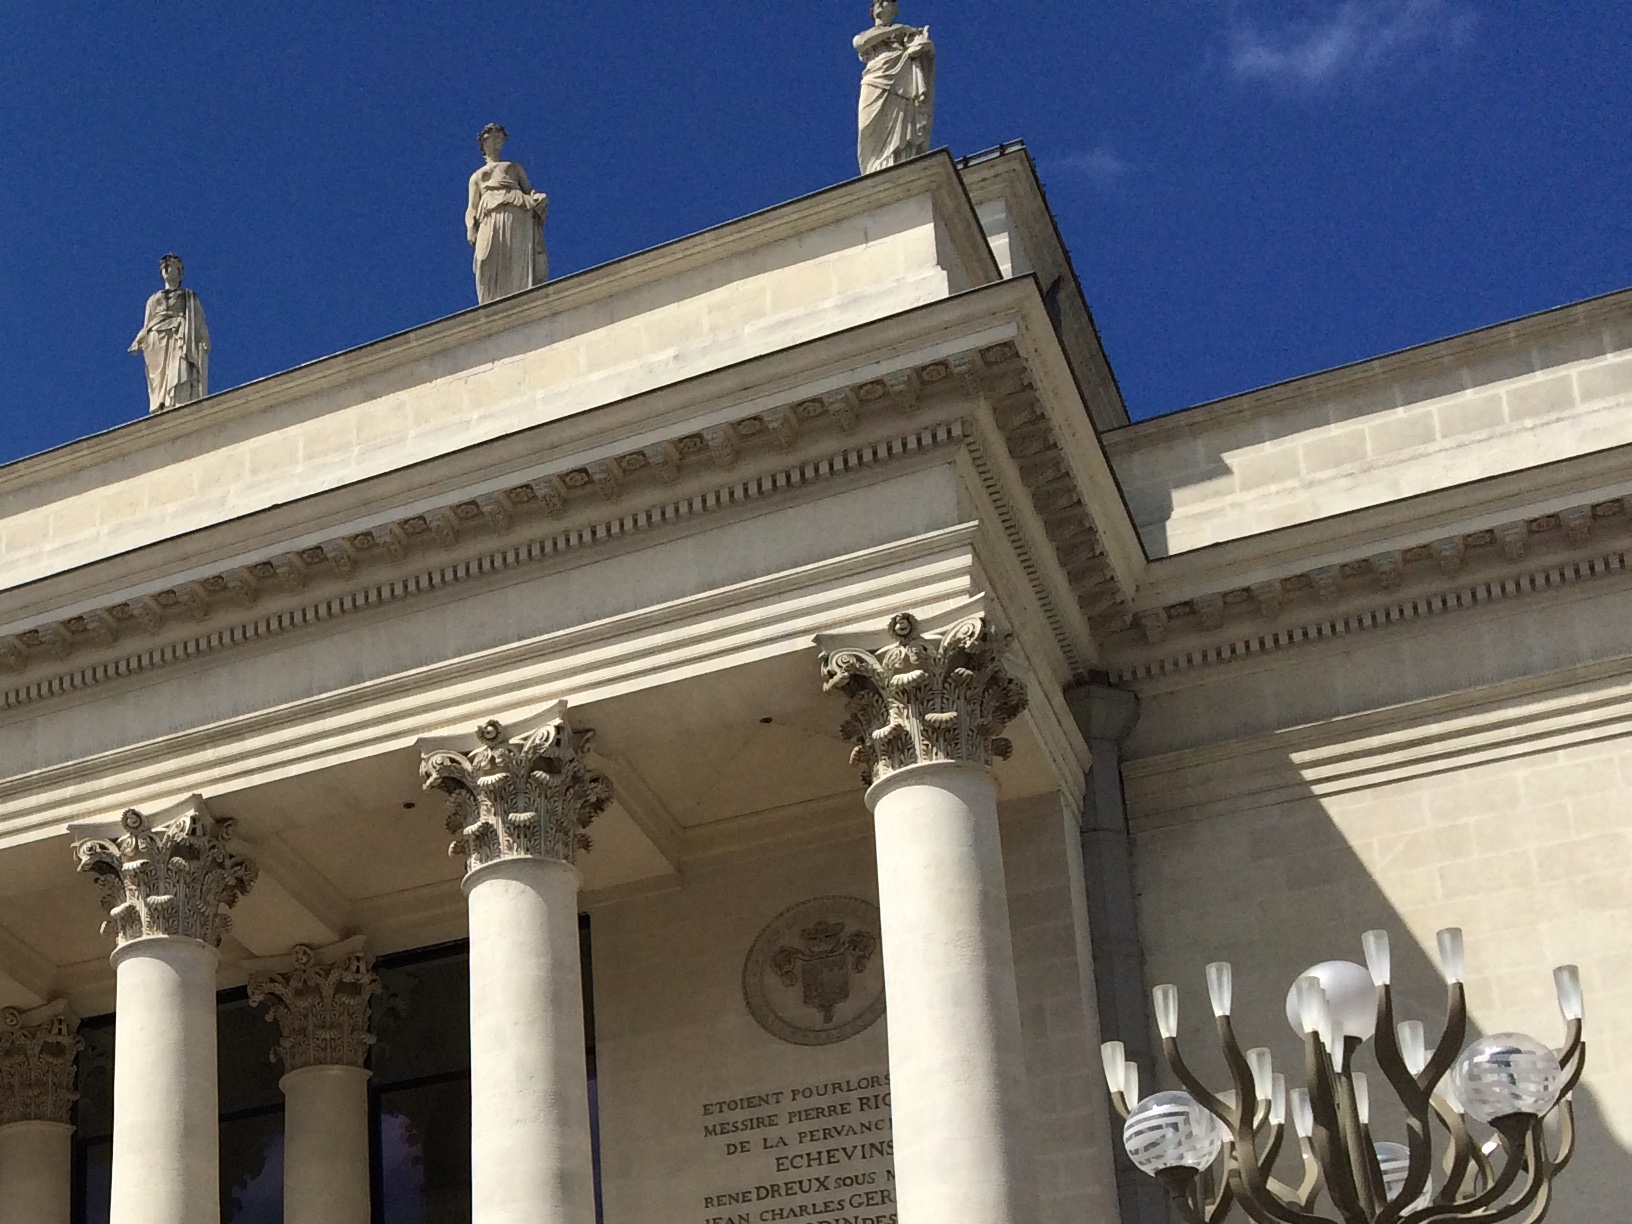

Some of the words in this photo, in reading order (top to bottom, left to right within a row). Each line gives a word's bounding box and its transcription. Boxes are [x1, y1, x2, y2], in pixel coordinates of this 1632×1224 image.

[702, 1092, 783, 1116] ETOIENT
[703, 1114, 778, 1138] MESSIRE
[788, 1102, 851, 1124] PIERRE
[726, 1141, 750, 1156] DE
[763, 1136, 788, 1149] LA
[798, 1117, 892, 1144] PERVANC
[775, 1139, 894, 1172] ECHEVINS
[704, 1190, 752, 1209] RENE
[754, 1175, 831, 1202] DREUX
[834, 1171, 876, 1189] SOUS
[759, 1199, 846, 1222] CHARLES
